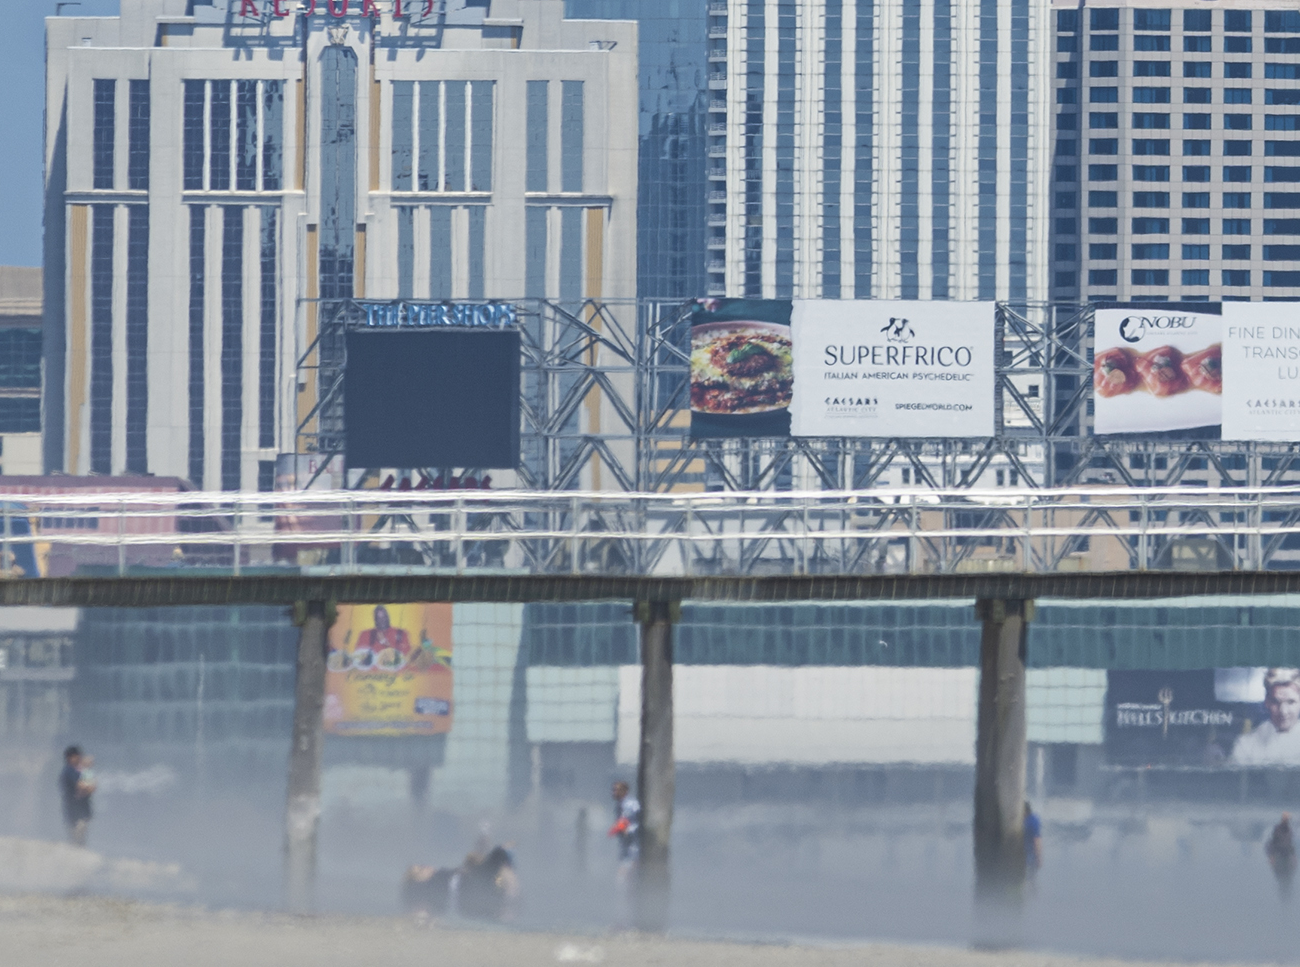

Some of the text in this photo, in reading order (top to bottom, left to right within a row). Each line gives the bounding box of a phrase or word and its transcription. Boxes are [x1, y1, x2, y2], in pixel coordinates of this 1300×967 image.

[452, 304, 516, 326] SHOPS
[1138, 316, 1197, 329] NOBU
[1228, 326, 1265, 339] FINE
[823, 345, 972, 367] SUPERFRICO
[824, 371, 971, 381] ITALIAN AMERICAN PSYCHEDELIC
[824, 396, 878, 406] CAESARS
